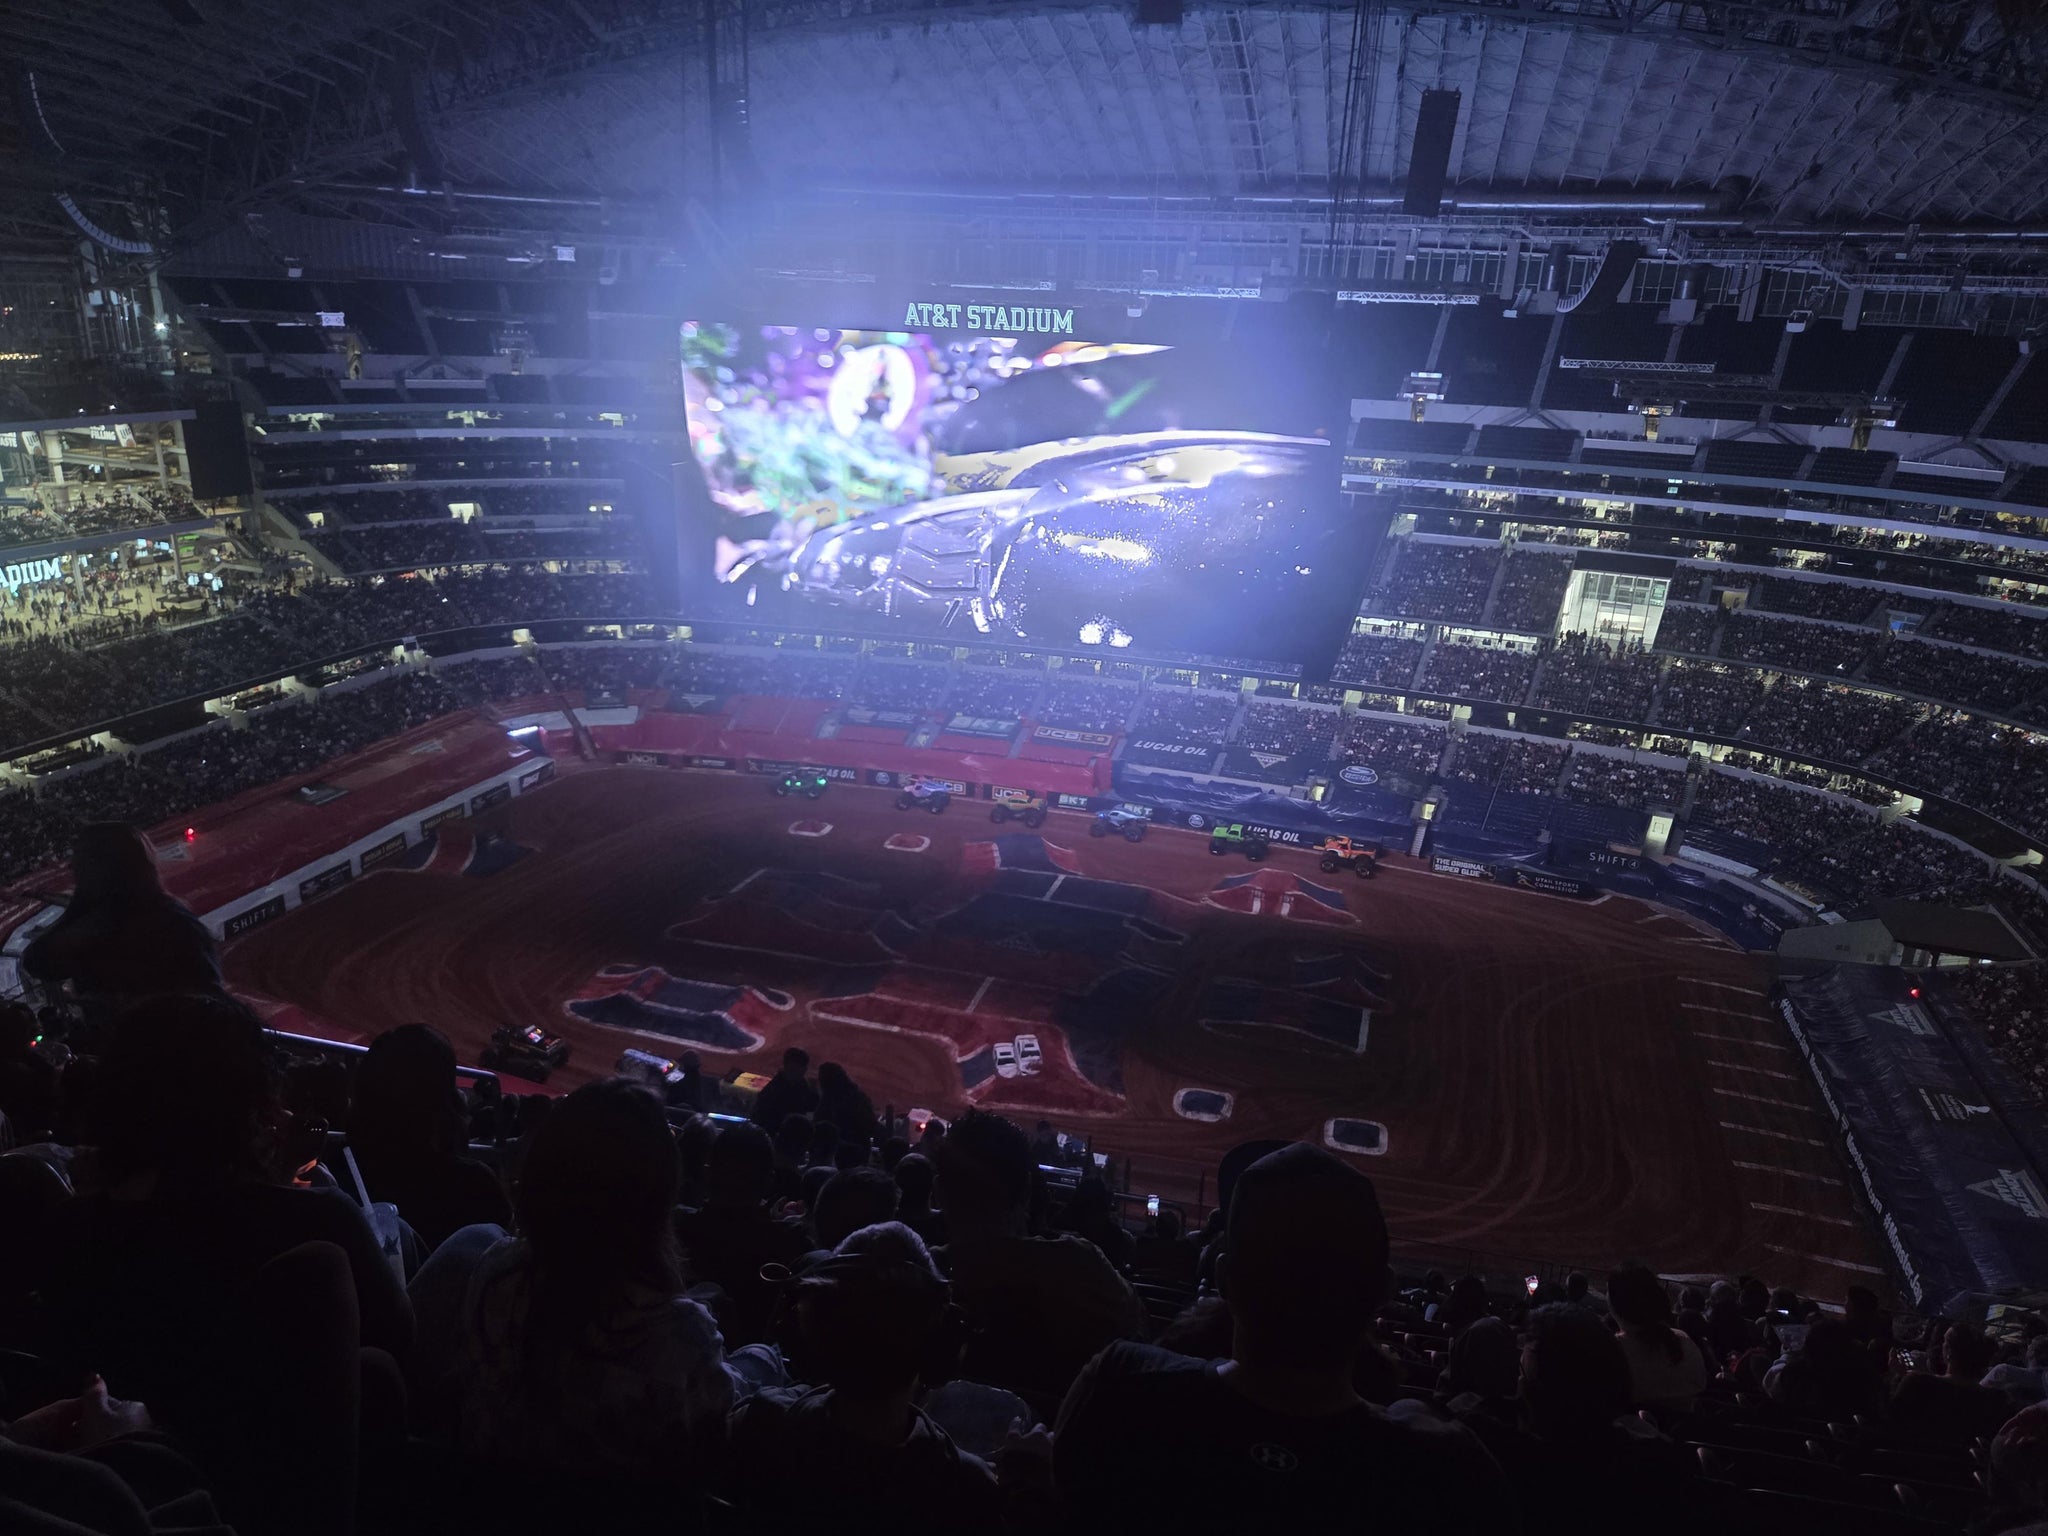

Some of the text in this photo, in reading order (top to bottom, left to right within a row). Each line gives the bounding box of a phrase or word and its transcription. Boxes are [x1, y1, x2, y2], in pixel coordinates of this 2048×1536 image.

[905, 302, 1074, 333] AT&T STADIUM
[1039, 729, 1080, 740] JCB
[1134, 740, 1209, 756] LUCAS OIL
[840, 769, 856, 780] OIL
[1058, 793, 1088, 805] BKT
[1282, 831, 1300, 842] OIL
[1435, 857, 1485, 872] THE ORIGINAL
[1589, 851, 1627, 867] SHIFT
[1434, 863, 1481, 878] SUPER GLUE
[1534, 881, 1578, 894] COMMISSION
[232, 908, 266, 934] SHIFT
[1997, 1168, 2041, 1218] MONSTER
